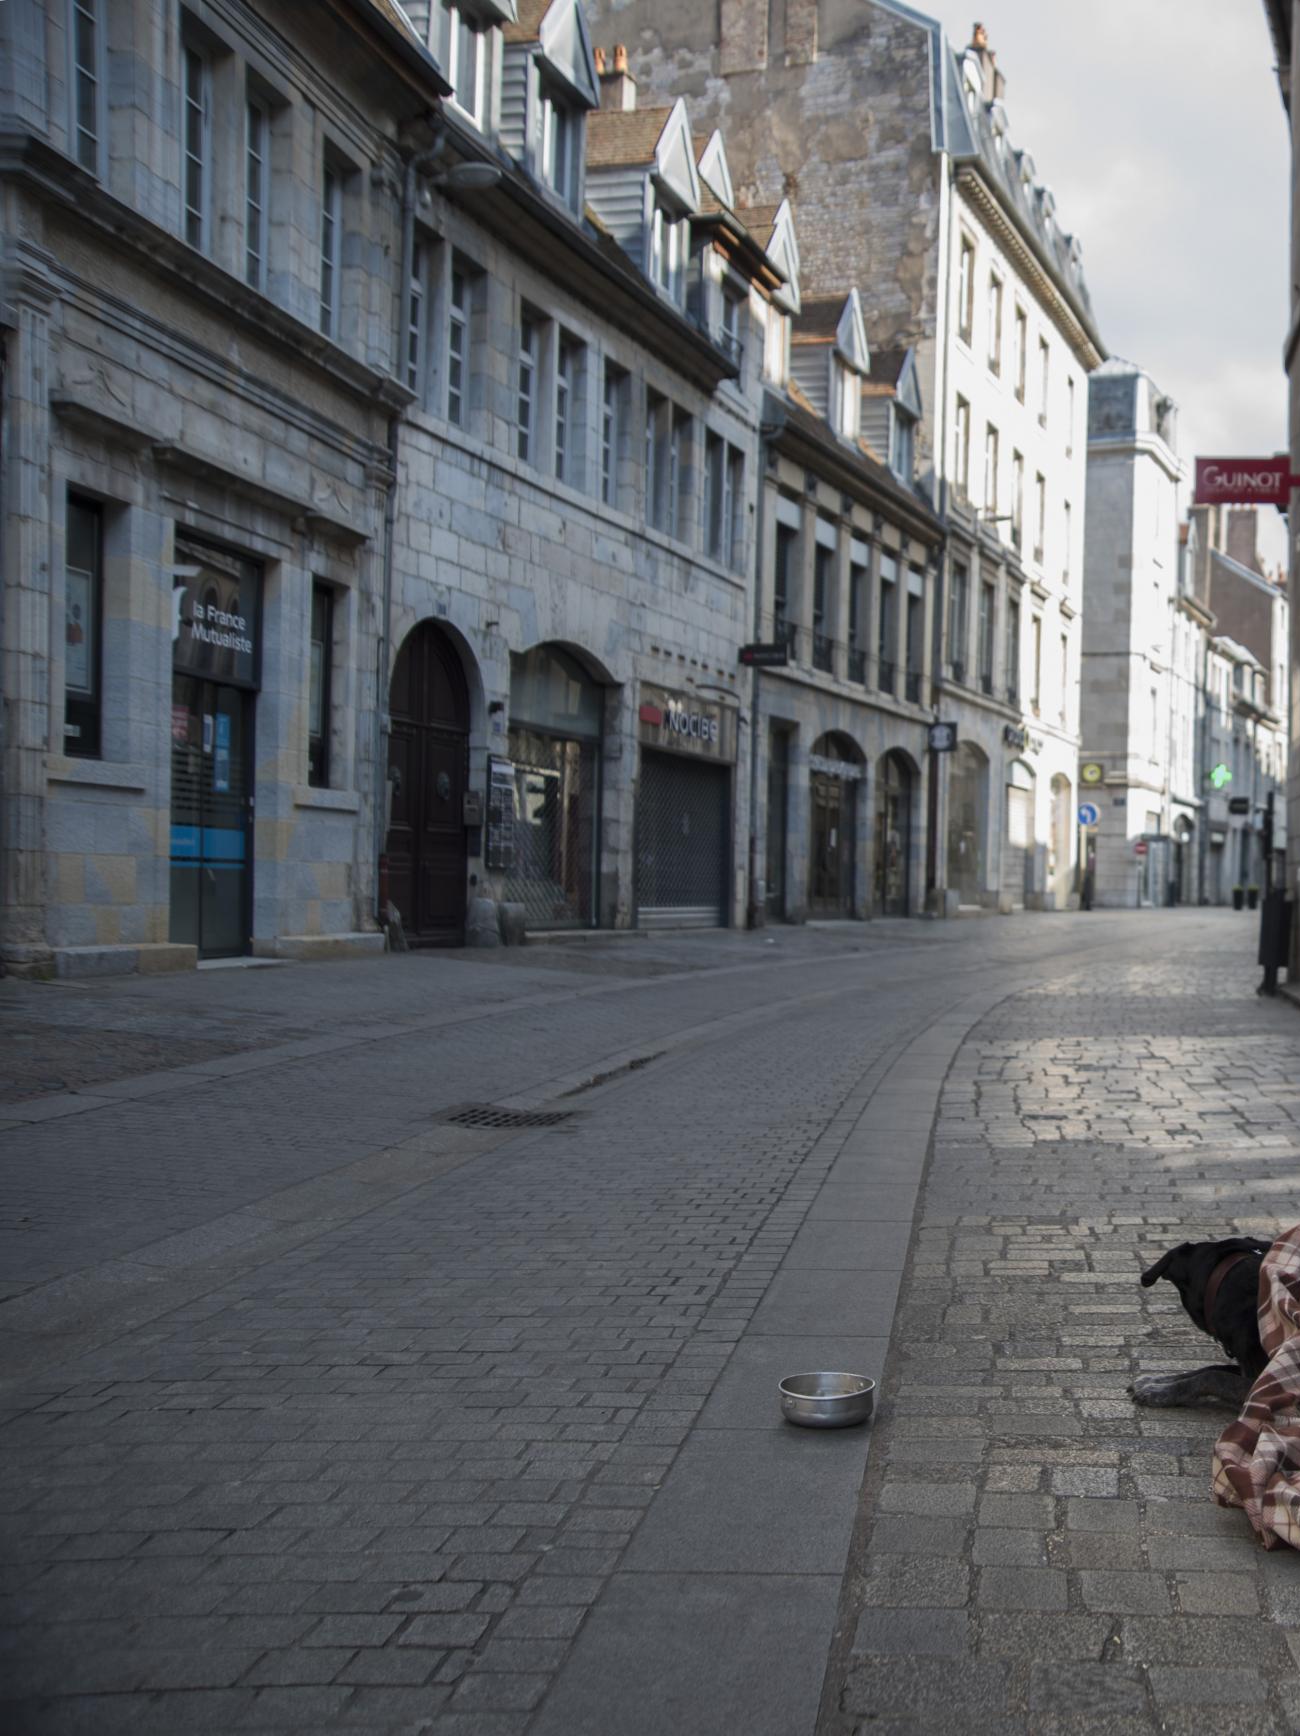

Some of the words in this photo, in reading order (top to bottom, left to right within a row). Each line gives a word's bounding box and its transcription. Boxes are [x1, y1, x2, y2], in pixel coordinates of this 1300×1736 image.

[1202, 465, 1283, 488] GUINOT
[193, 600, 204, 619] la
[207, 604, 246, 631] France
[191, 621, 252, 654] Mutualiste
